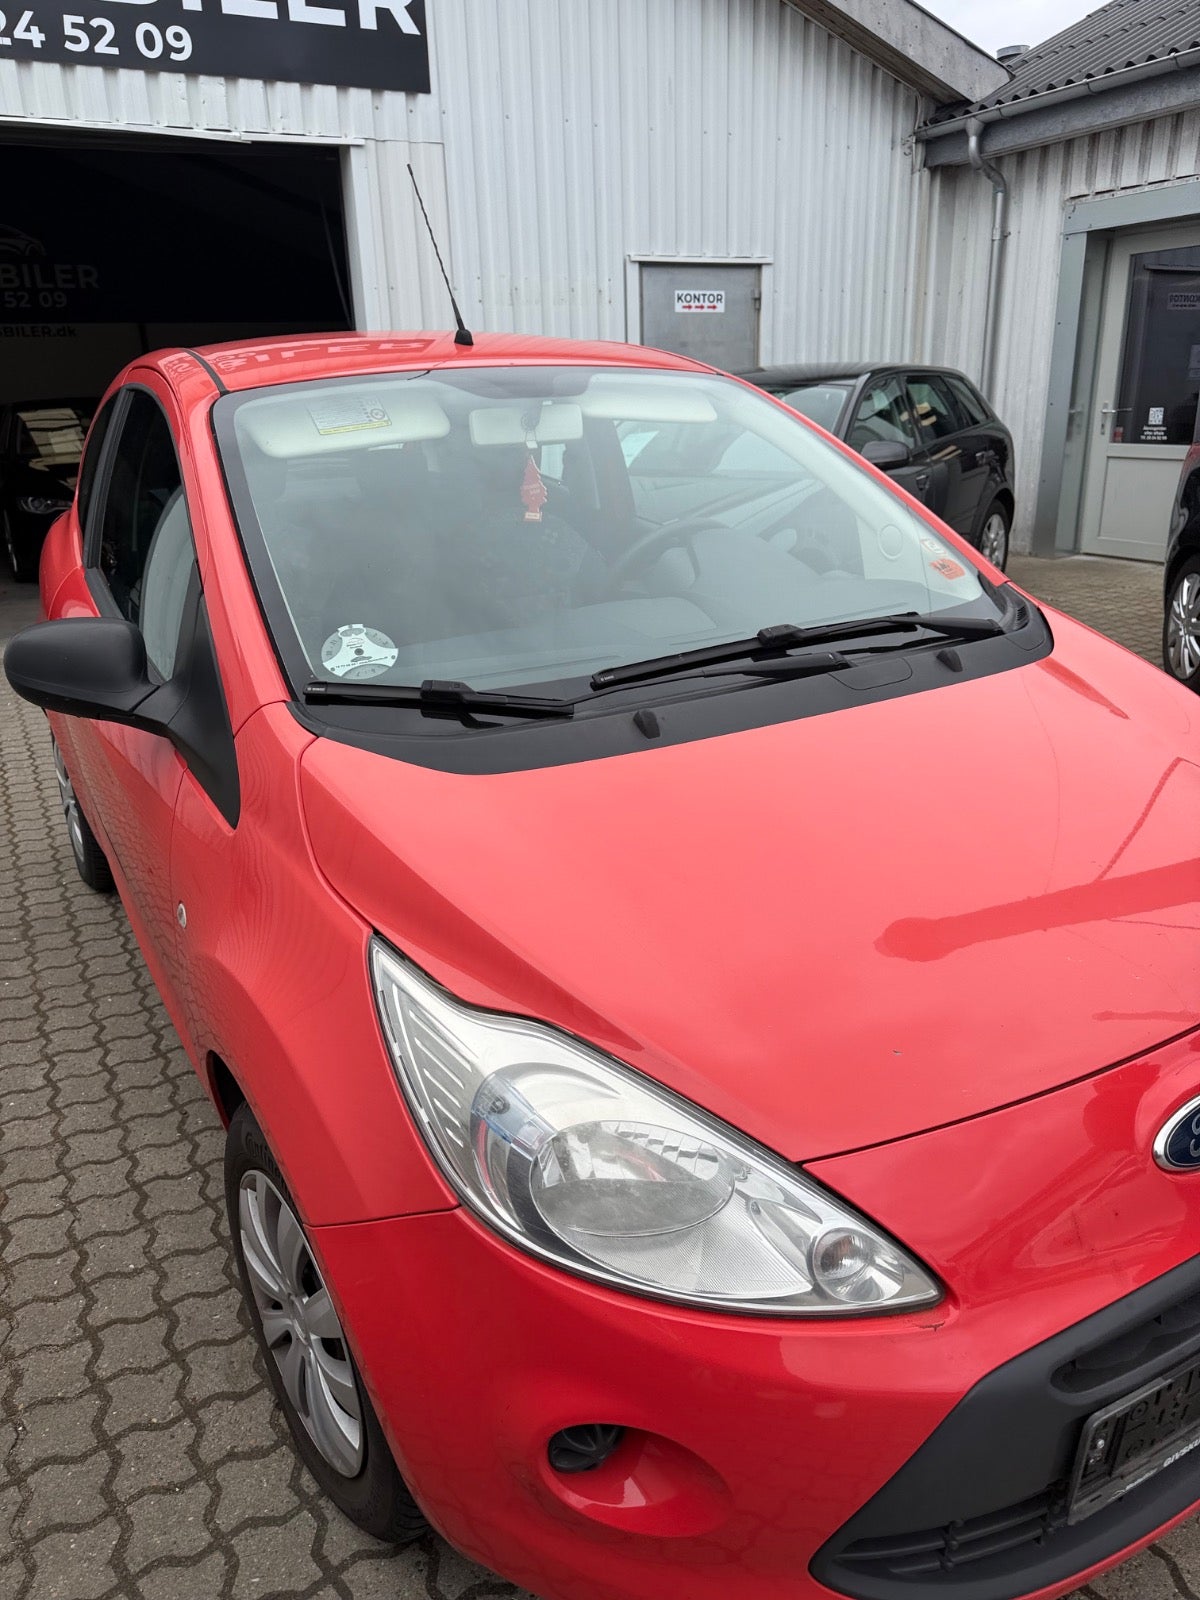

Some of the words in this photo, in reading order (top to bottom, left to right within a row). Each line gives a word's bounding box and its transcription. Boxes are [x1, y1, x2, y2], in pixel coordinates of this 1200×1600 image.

[63, 15, 119, 55] 52
[135, 22, 193, 61] 09
[4, 292, 32, 308] 52
[38, 292, 67, 308] 09
[677, 293, 723, 304] KONTOR
